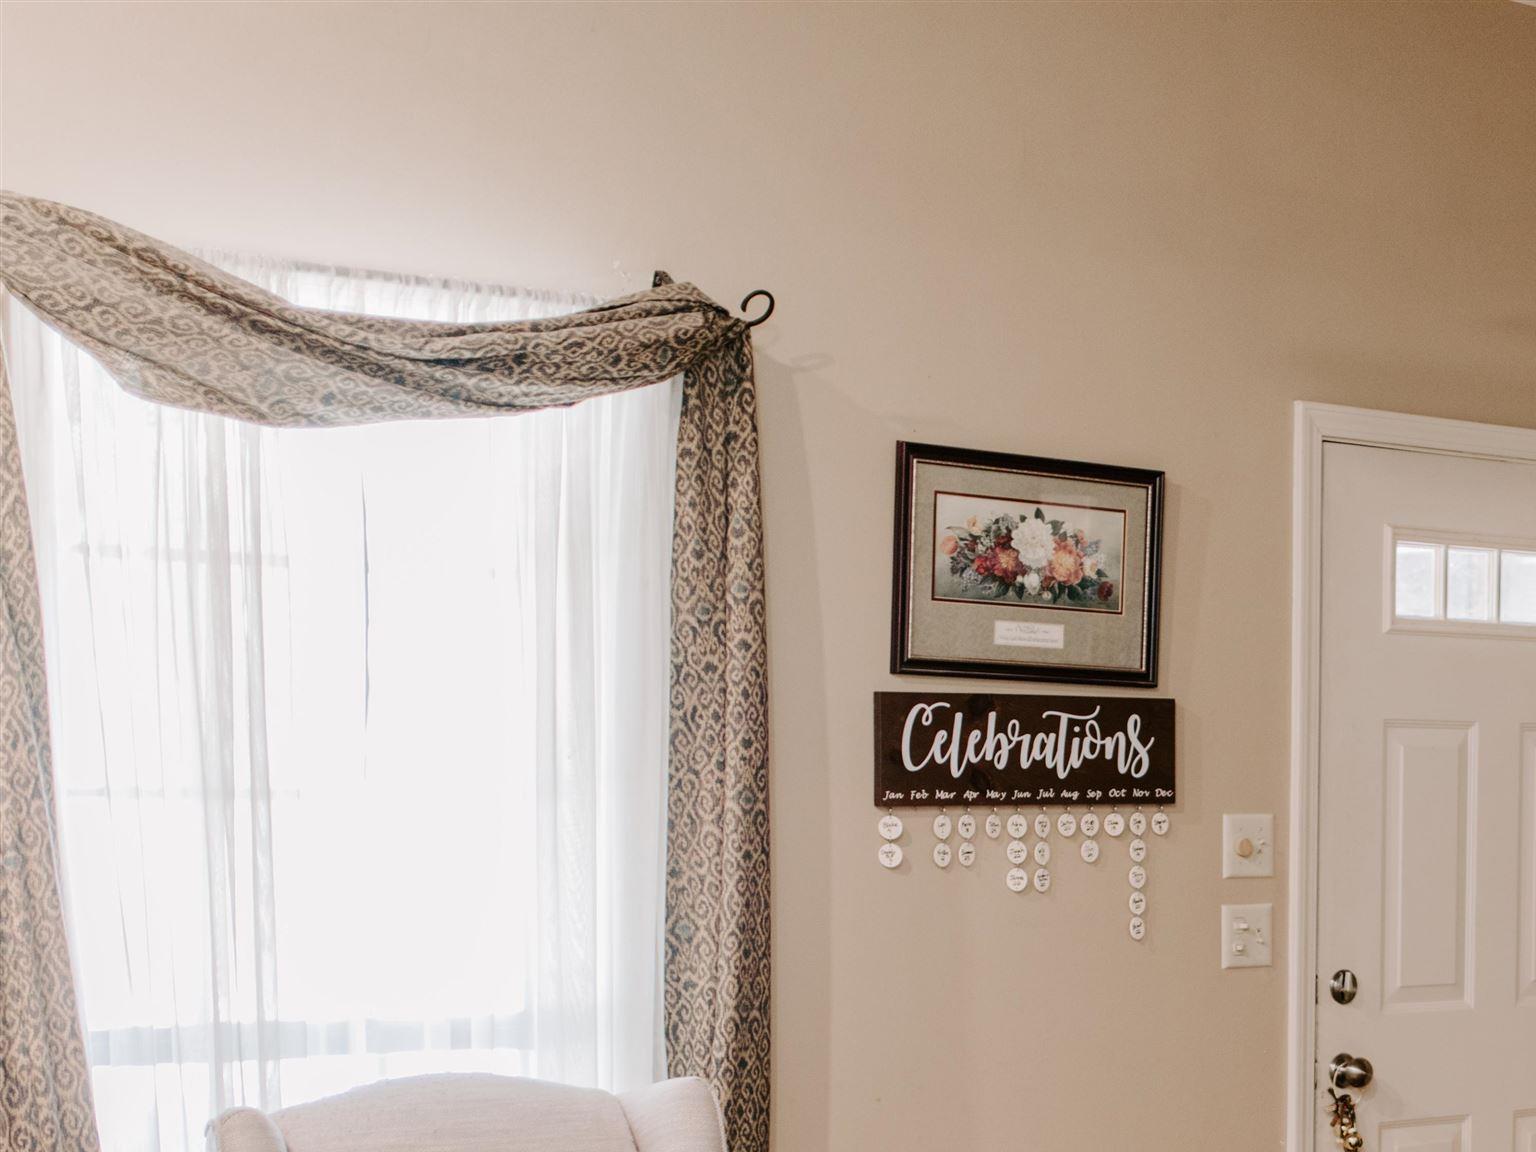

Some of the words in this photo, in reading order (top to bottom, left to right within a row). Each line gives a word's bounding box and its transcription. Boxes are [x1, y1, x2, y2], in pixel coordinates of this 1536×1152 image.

[902, 702, 1155, 779] Celebrations
[883, 789, 904, 801] Jan
[910, 790, 929, 800] Feb
[935, 789, 956, 799] Mar
[963, 789, 979, 801] Apr
[986, 789, 1006, 801] May
[1011, 789, 1031, 799] Jun
[1036, 788, 1055, 799] Jul
[1060, 788, 1079, 801] Aug
[1086, 788, 1102, 800] Sep
[1108, 788, 1127, 798] Oct
[1132, 788, 1151, 798] Nov
[1155, 788, 1174, 798] Dec
